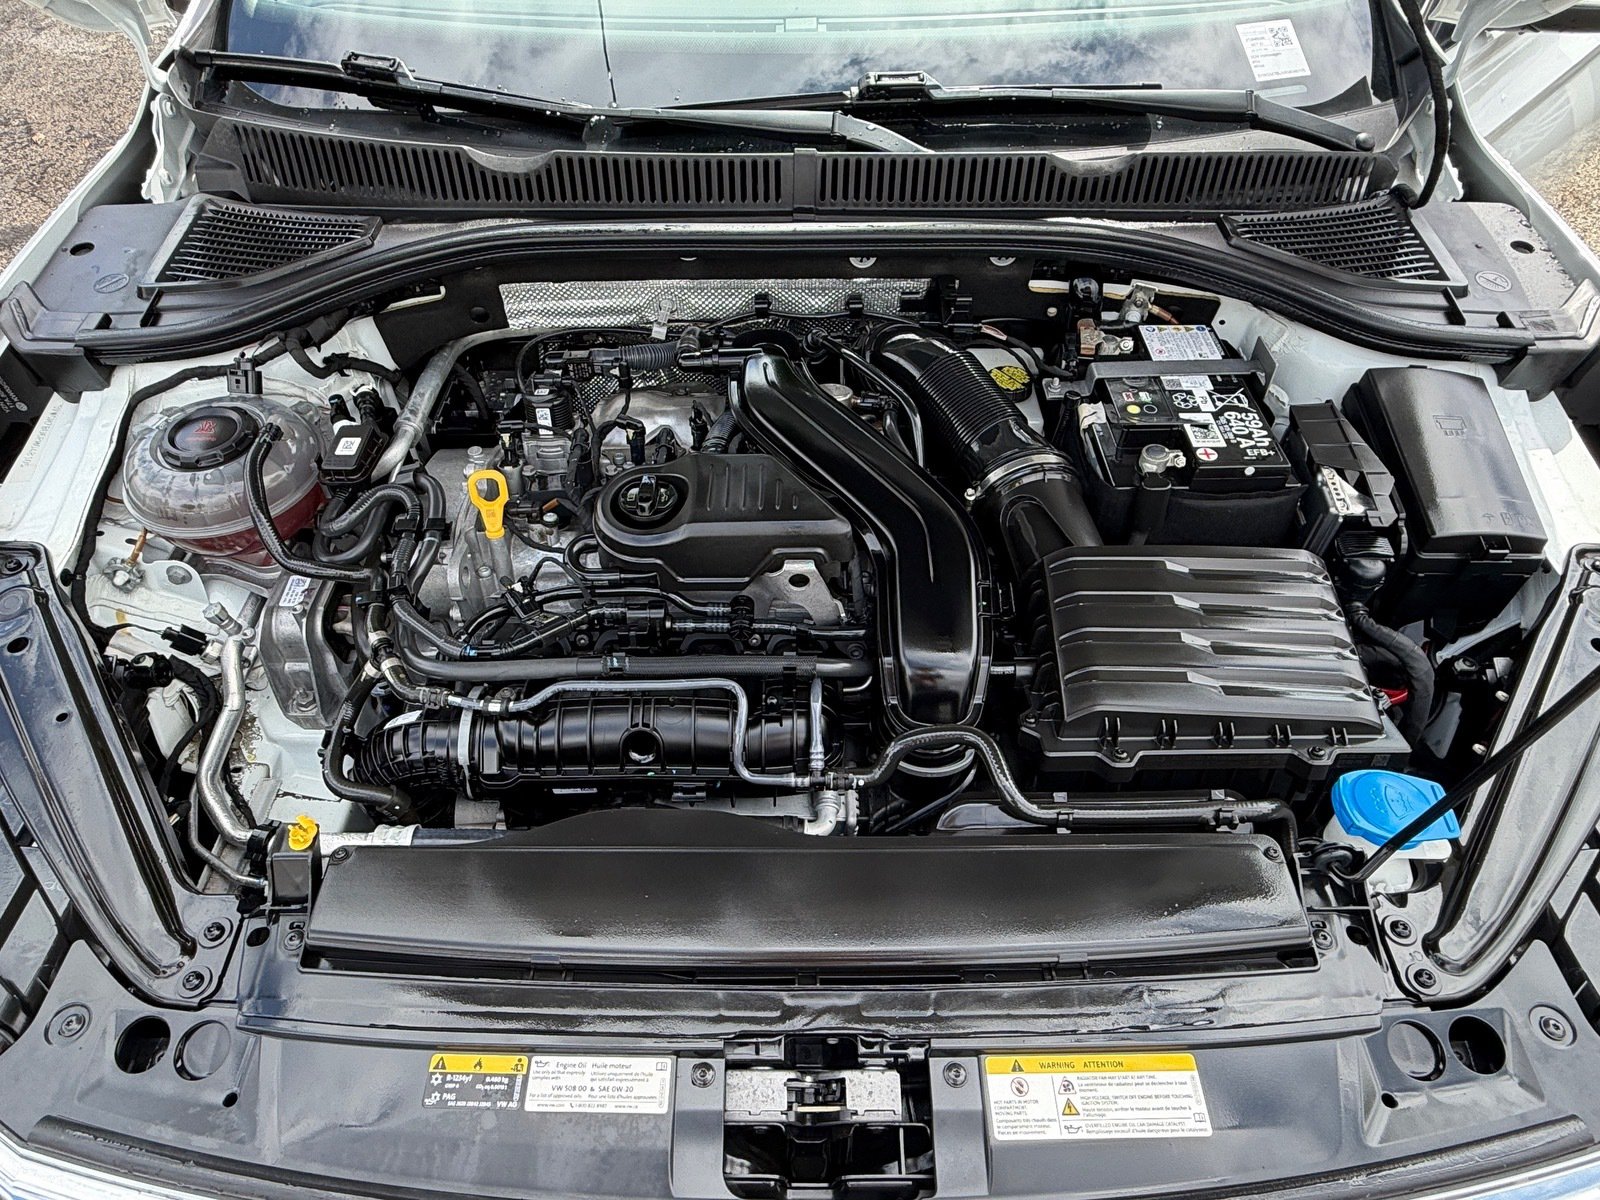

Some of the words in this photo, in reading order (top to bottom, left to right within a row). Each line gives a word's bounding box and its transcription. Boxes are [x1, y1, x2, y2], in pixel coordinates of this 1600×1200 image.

[1200, 396, 1208, 404] Pb
[1224, 412, 1250, 434] 640
[1241, 412, 1272, 446] 59Ah
[1236, 438, 1256, 448] A
[556, 1062, 576, 1070] Engine
